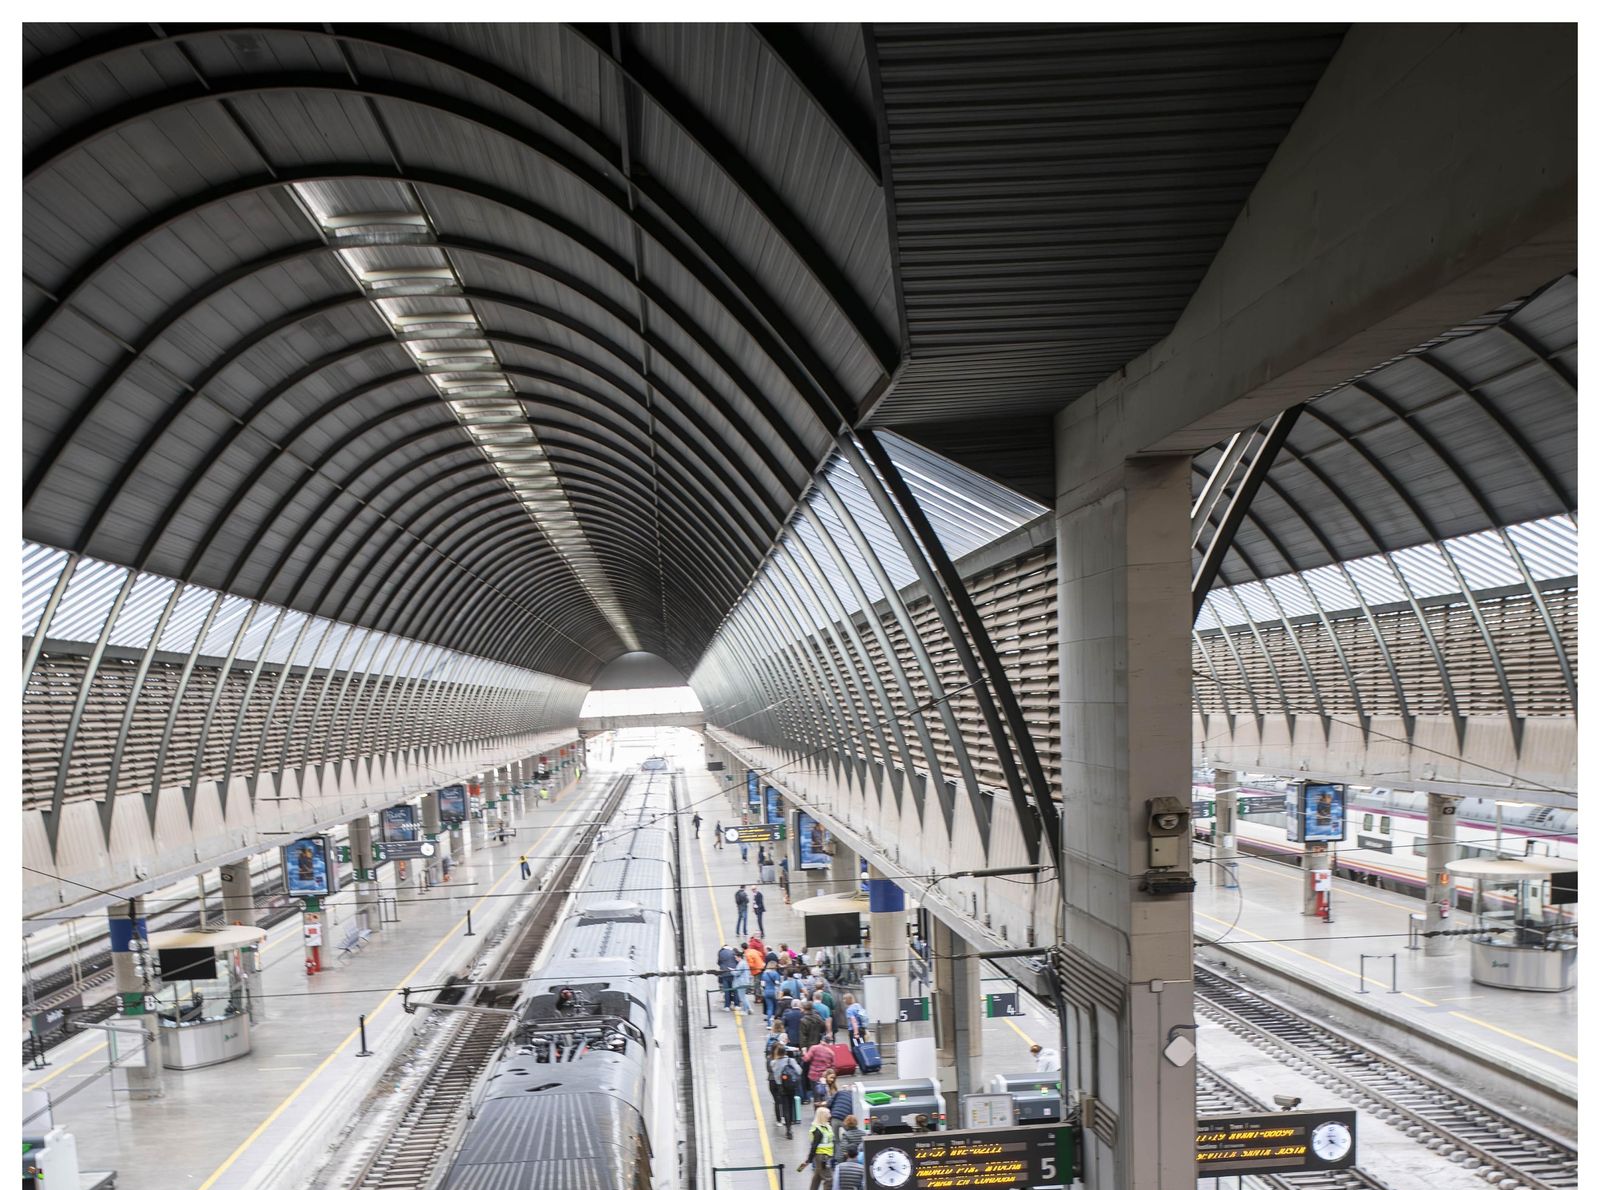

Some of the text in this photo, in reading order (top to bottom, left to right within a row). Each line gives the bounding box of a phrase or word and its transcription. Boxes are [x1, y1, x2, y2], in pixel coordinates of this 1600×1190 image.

[367, 870, 375, 879] E
[1007, 1004, 1016, 1015] 4
[900, 1010, 908, 1021] 5
[1040, 1157, 1057, 1180] 5
